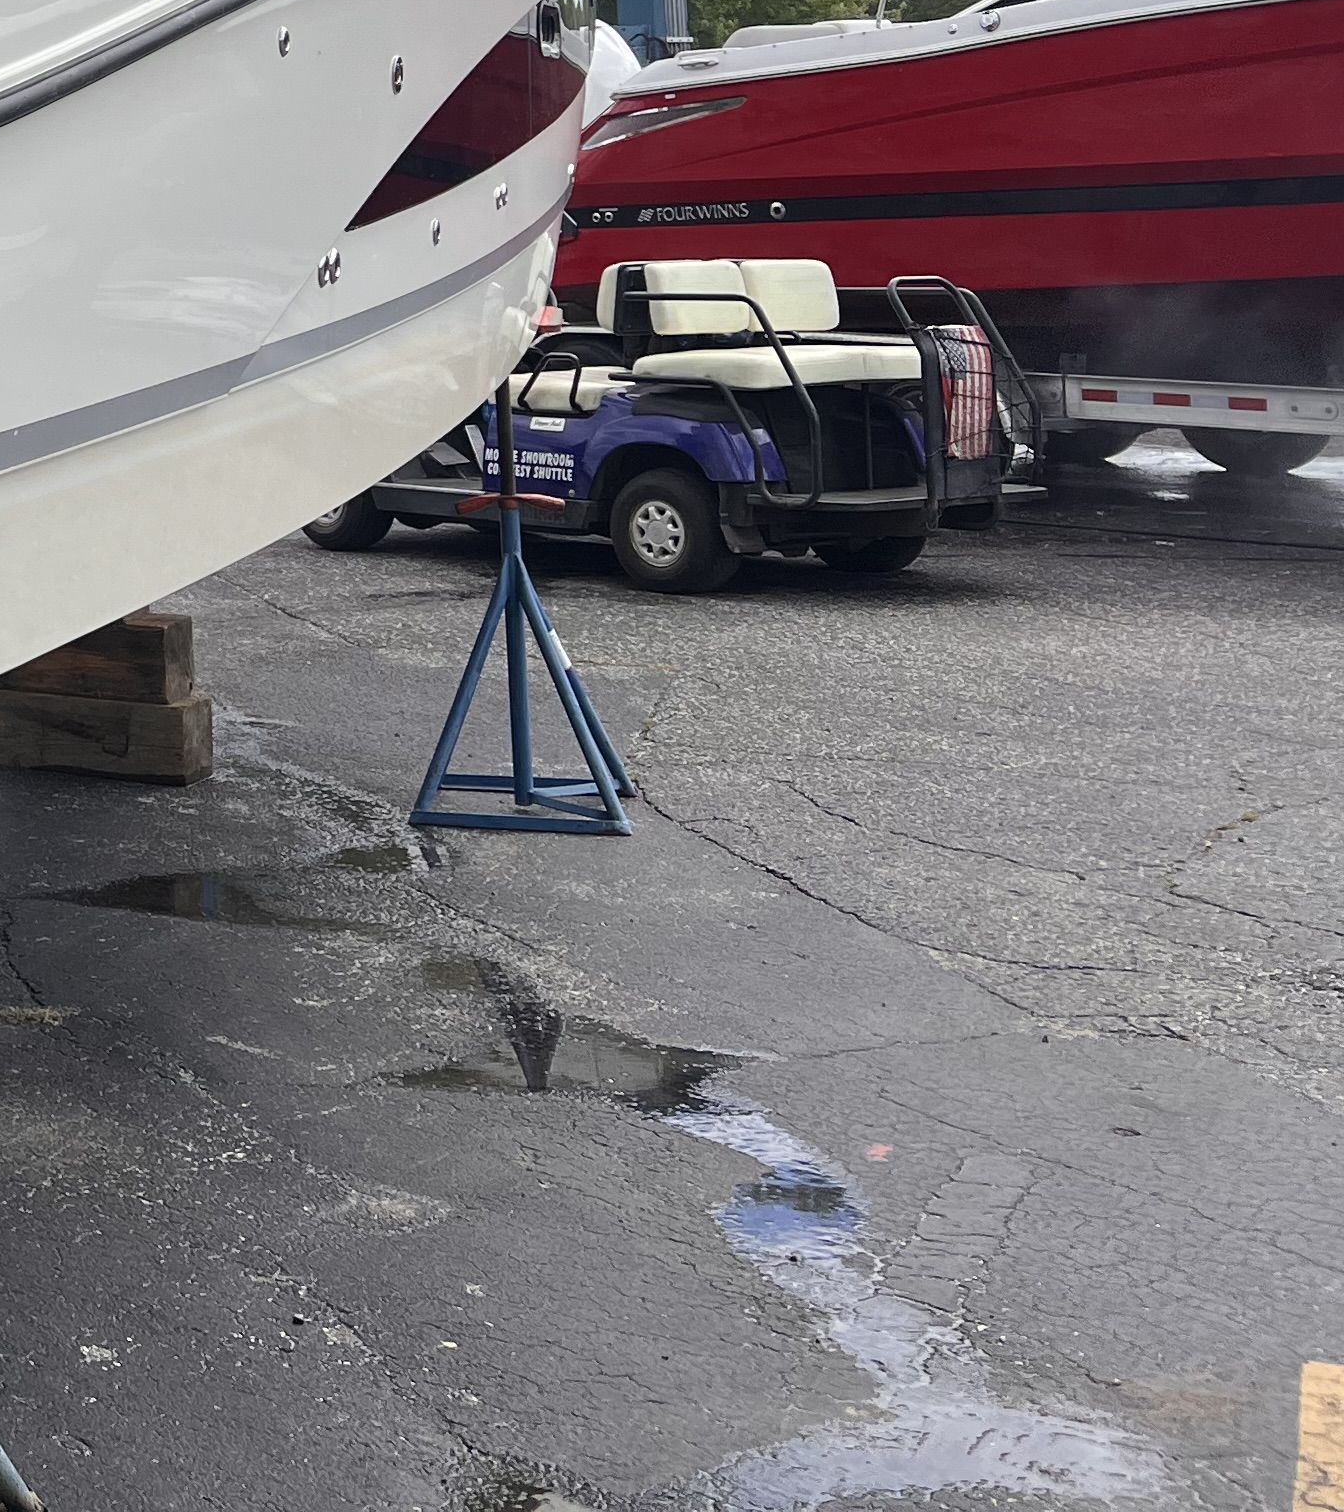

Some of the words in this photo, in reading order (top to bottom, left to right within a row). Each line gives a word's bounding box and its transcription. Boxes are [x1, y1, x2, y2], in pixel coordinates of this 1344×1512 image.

[656, 206, 696, 222] FOUR
[696, 202, 750, 220] WINNS
[485, 448, 518, 463] MOE
[520, 450, 574, 468] SHOWROOM
[487, 462, 532, 479] COESY
[533, 466, 573, 482] SHUTTLE
